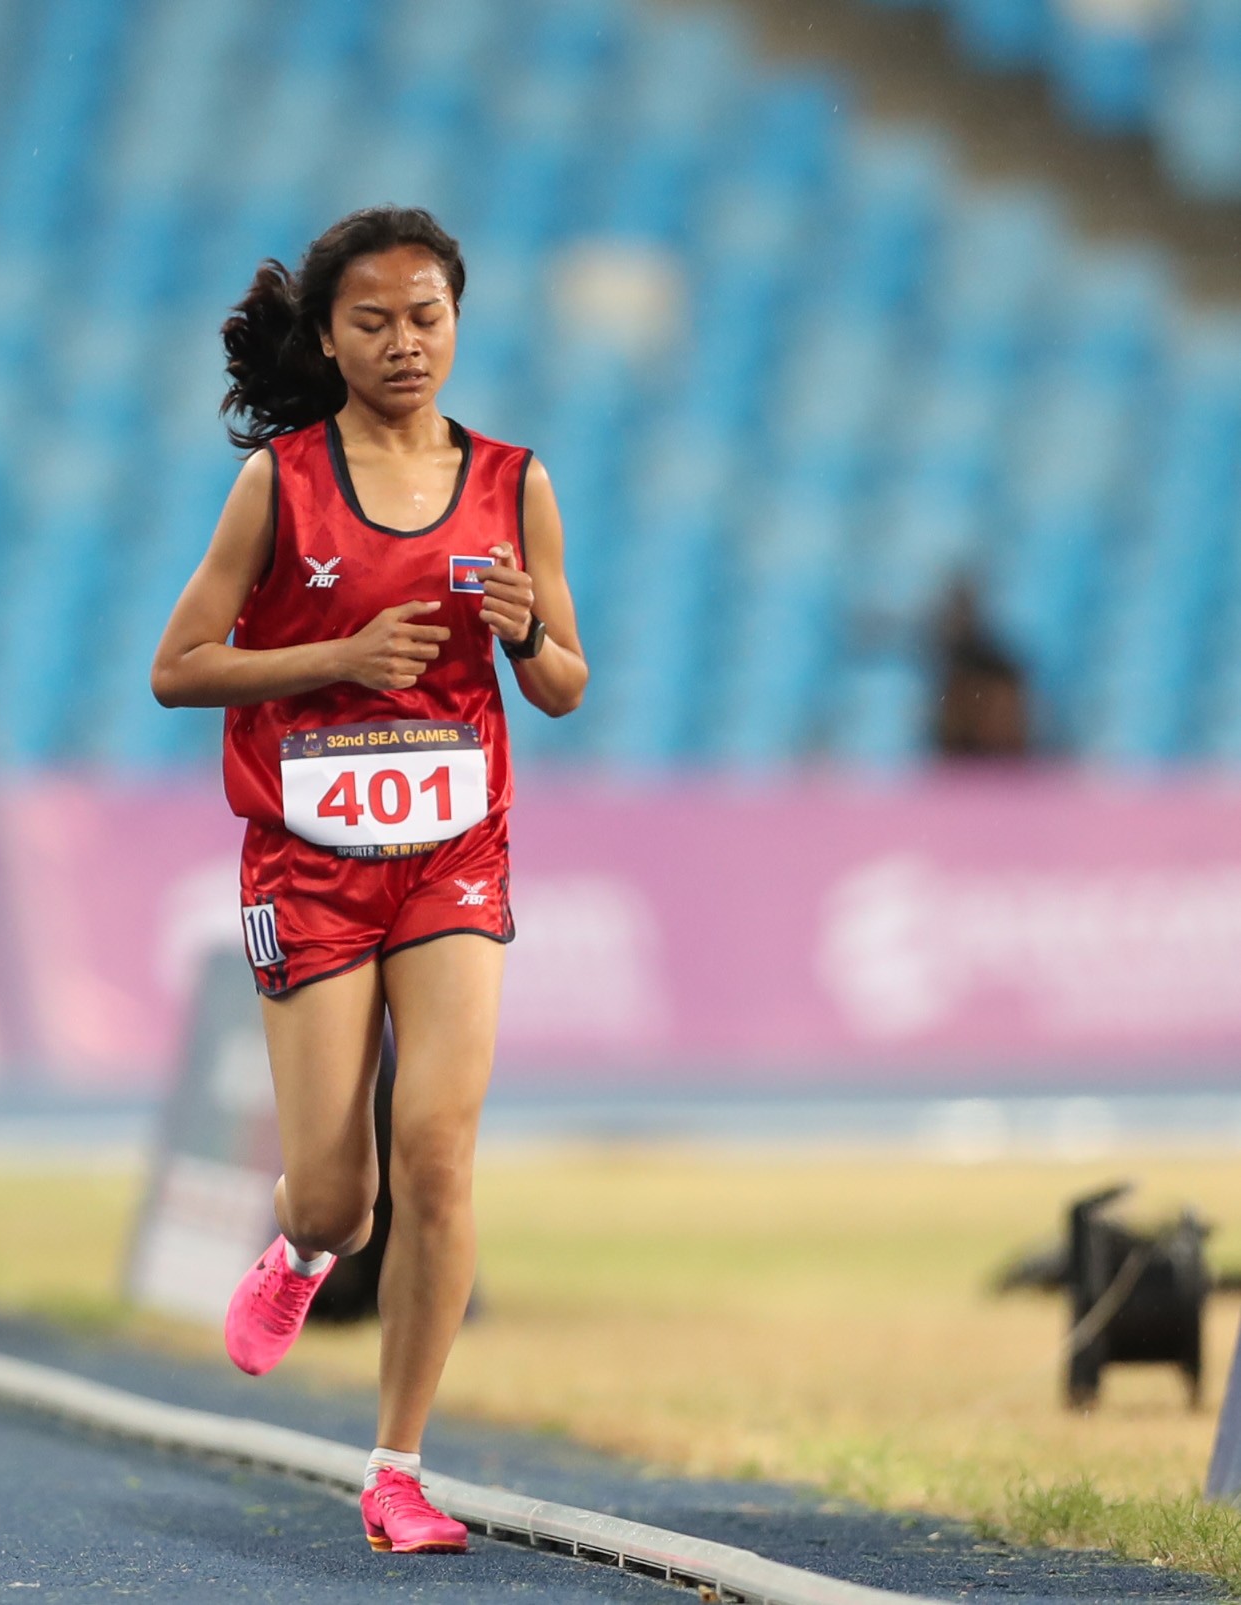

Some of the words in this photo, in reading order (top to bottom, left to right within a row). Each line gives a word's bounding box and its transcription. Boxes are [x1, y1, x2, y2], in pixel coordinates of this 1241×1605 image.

[305, 574, 341, 588] FBT
[326, 733, 364, 748] 32nd
[368, 731, 400, 745] SEA
[403, 729, 459, 743] GAMES
[317, 766, 452, 826] 401
[456, 894, 488, 906] FBT
[247, 908, 278, 963] 10
